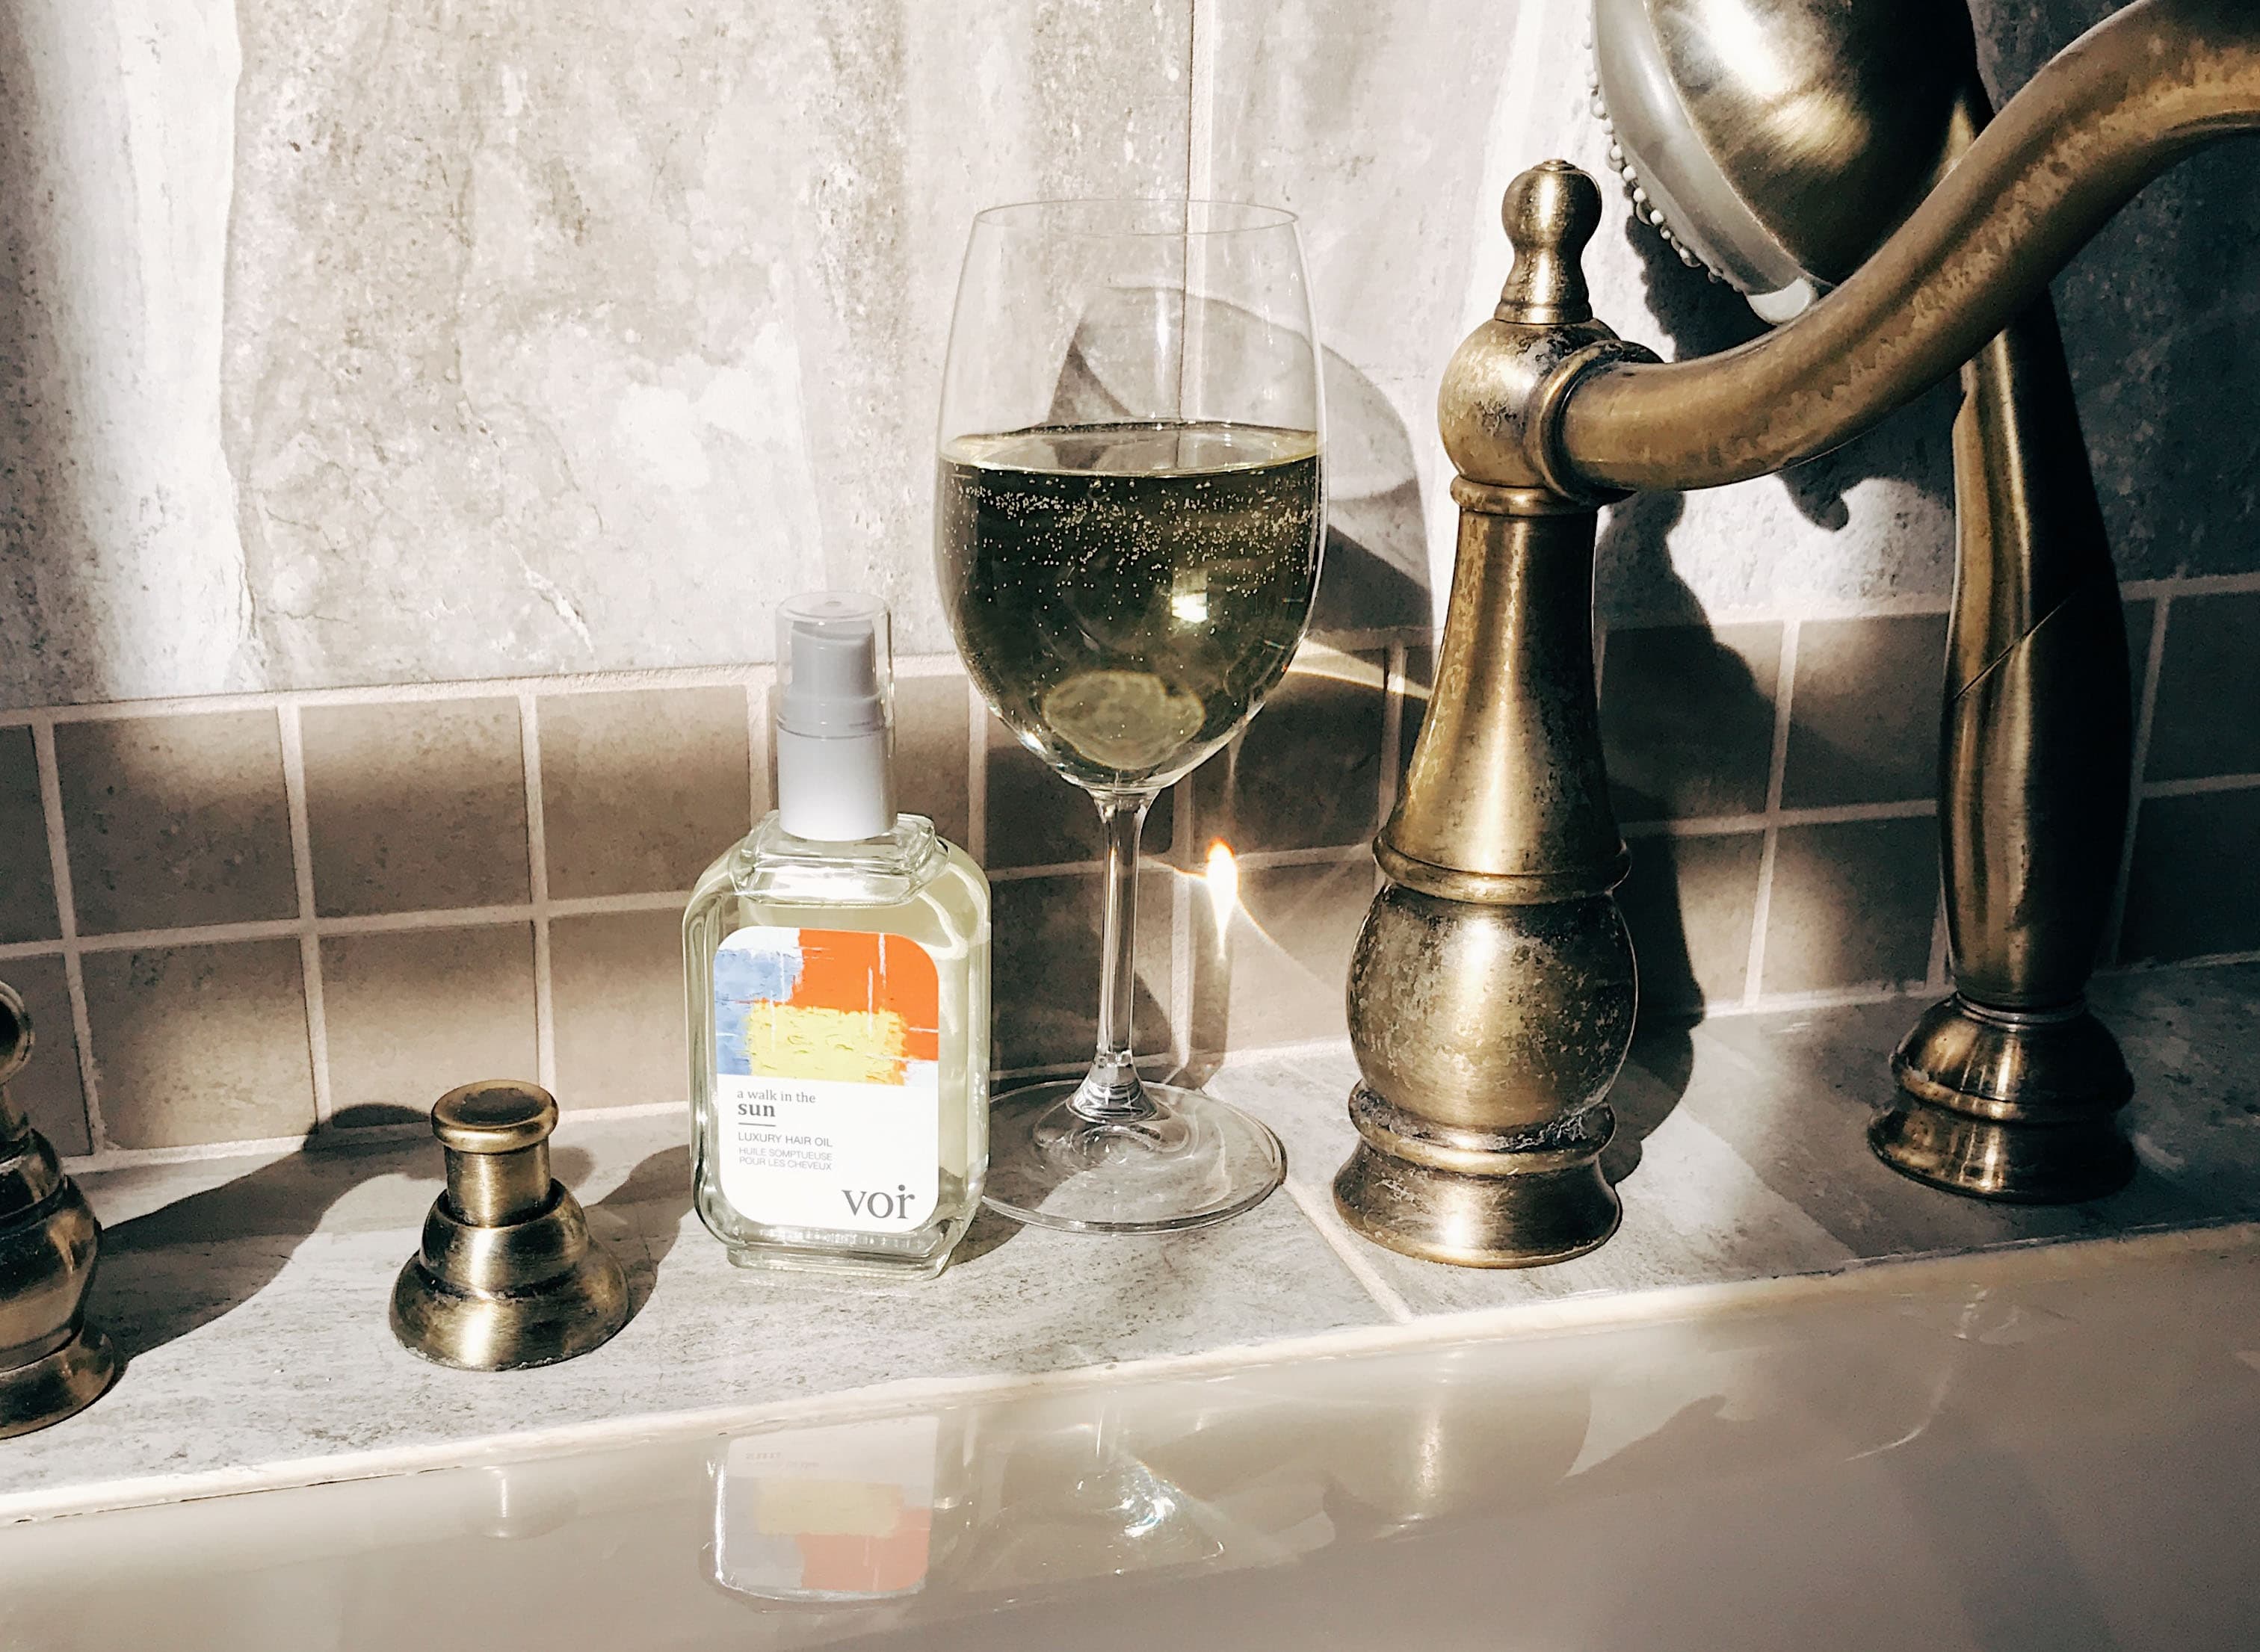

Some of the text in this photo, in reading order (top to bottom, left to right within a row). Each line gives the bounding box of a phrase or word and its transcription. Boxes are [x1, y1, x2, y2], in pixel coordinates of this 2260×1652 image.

[747, 1089, 777, 1101] walk
[780, 1091, 791, 1102] in
[797, 1092, 815, 1103] the
[738, 1103, 776, 1117] sun
[738, 1133, 833, 1147] LUXURY HAIR OIL
[739, 1148, 832, 1161] HUILE SOMPTUEUSE
[739, 1157, 832, 1171] POUR LES CHEVEUX
